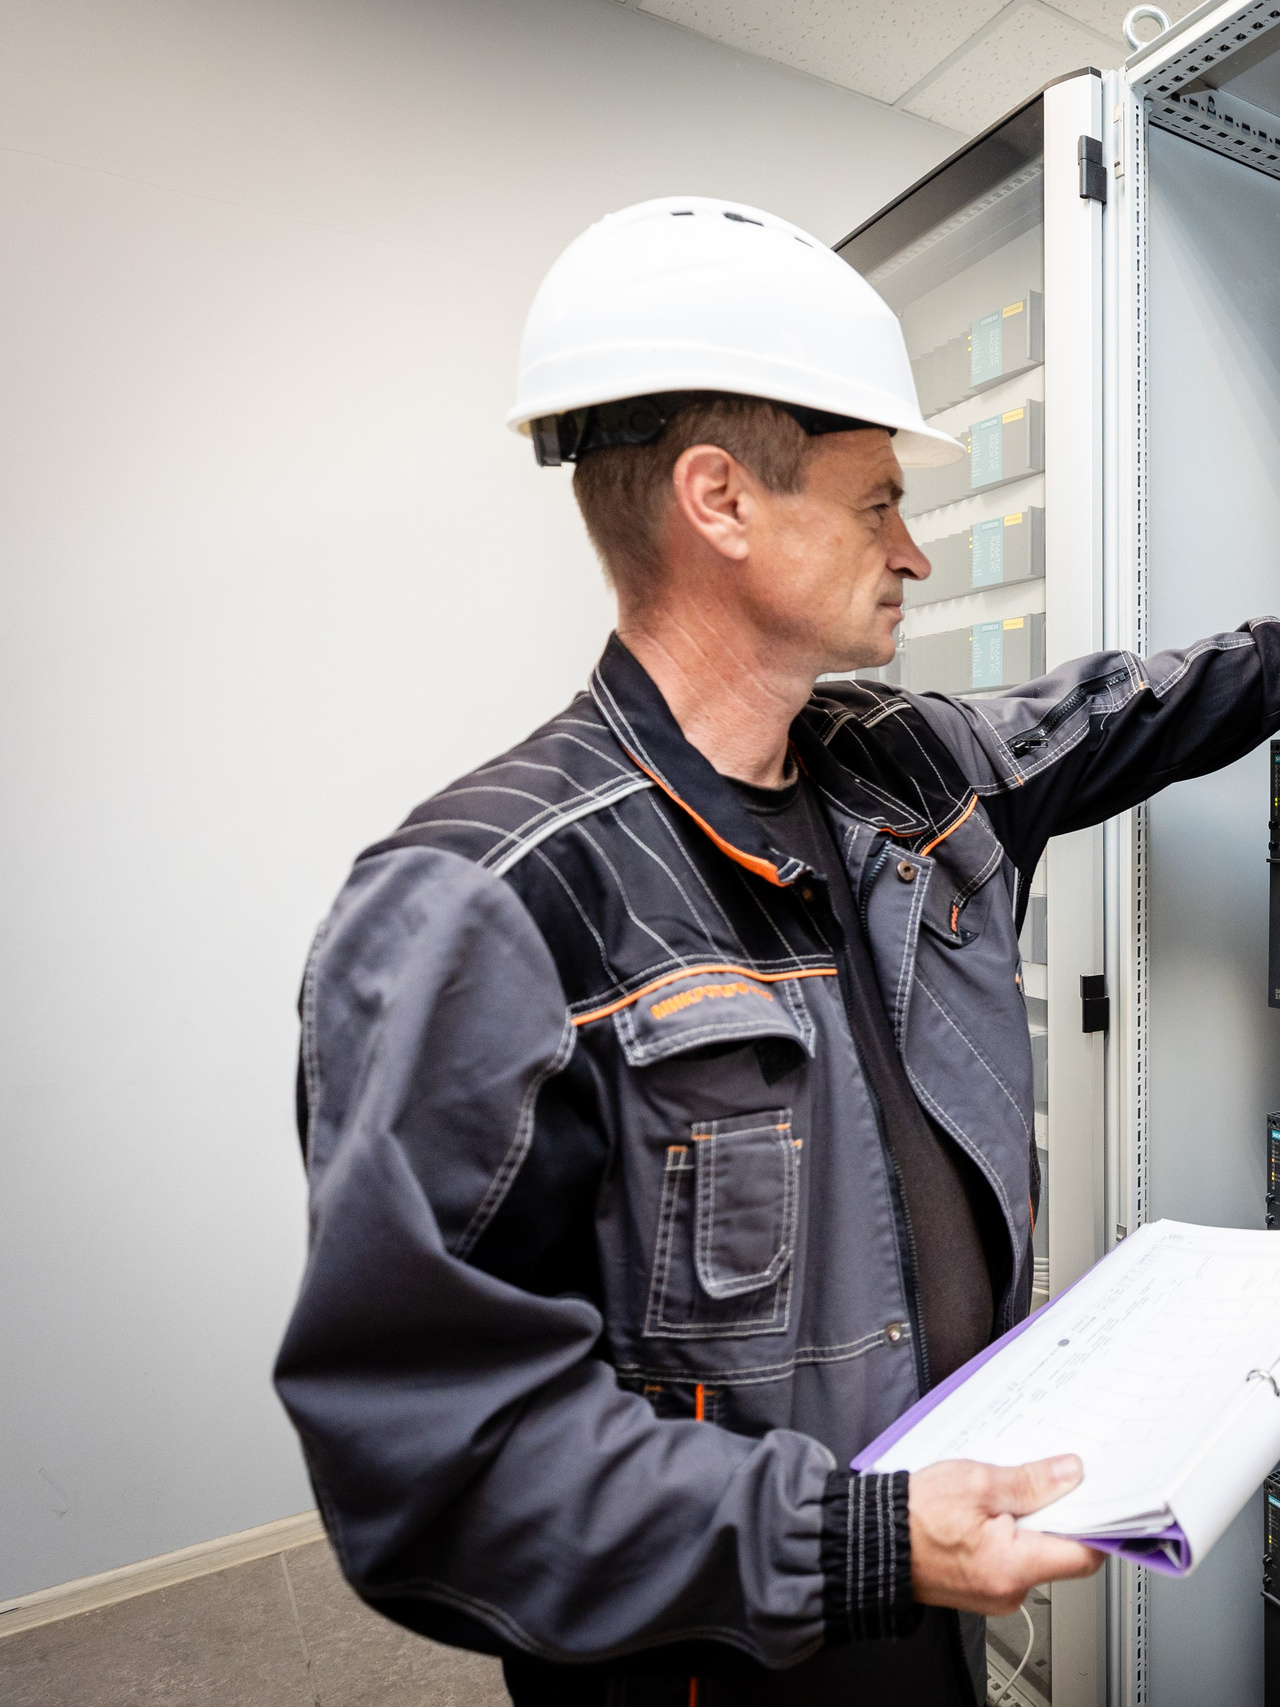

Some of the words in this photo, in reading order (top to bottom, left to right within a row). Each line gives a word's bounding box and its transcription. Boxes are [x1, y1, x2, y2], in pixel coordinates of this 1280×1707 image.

[980, 313, 999, 327] SIEMENS
[980, 418, 998, 430] SIEMENS
[981, 520, 1000, 531] SIEMENS
[981, 623, 999, 632] SIEMENS
